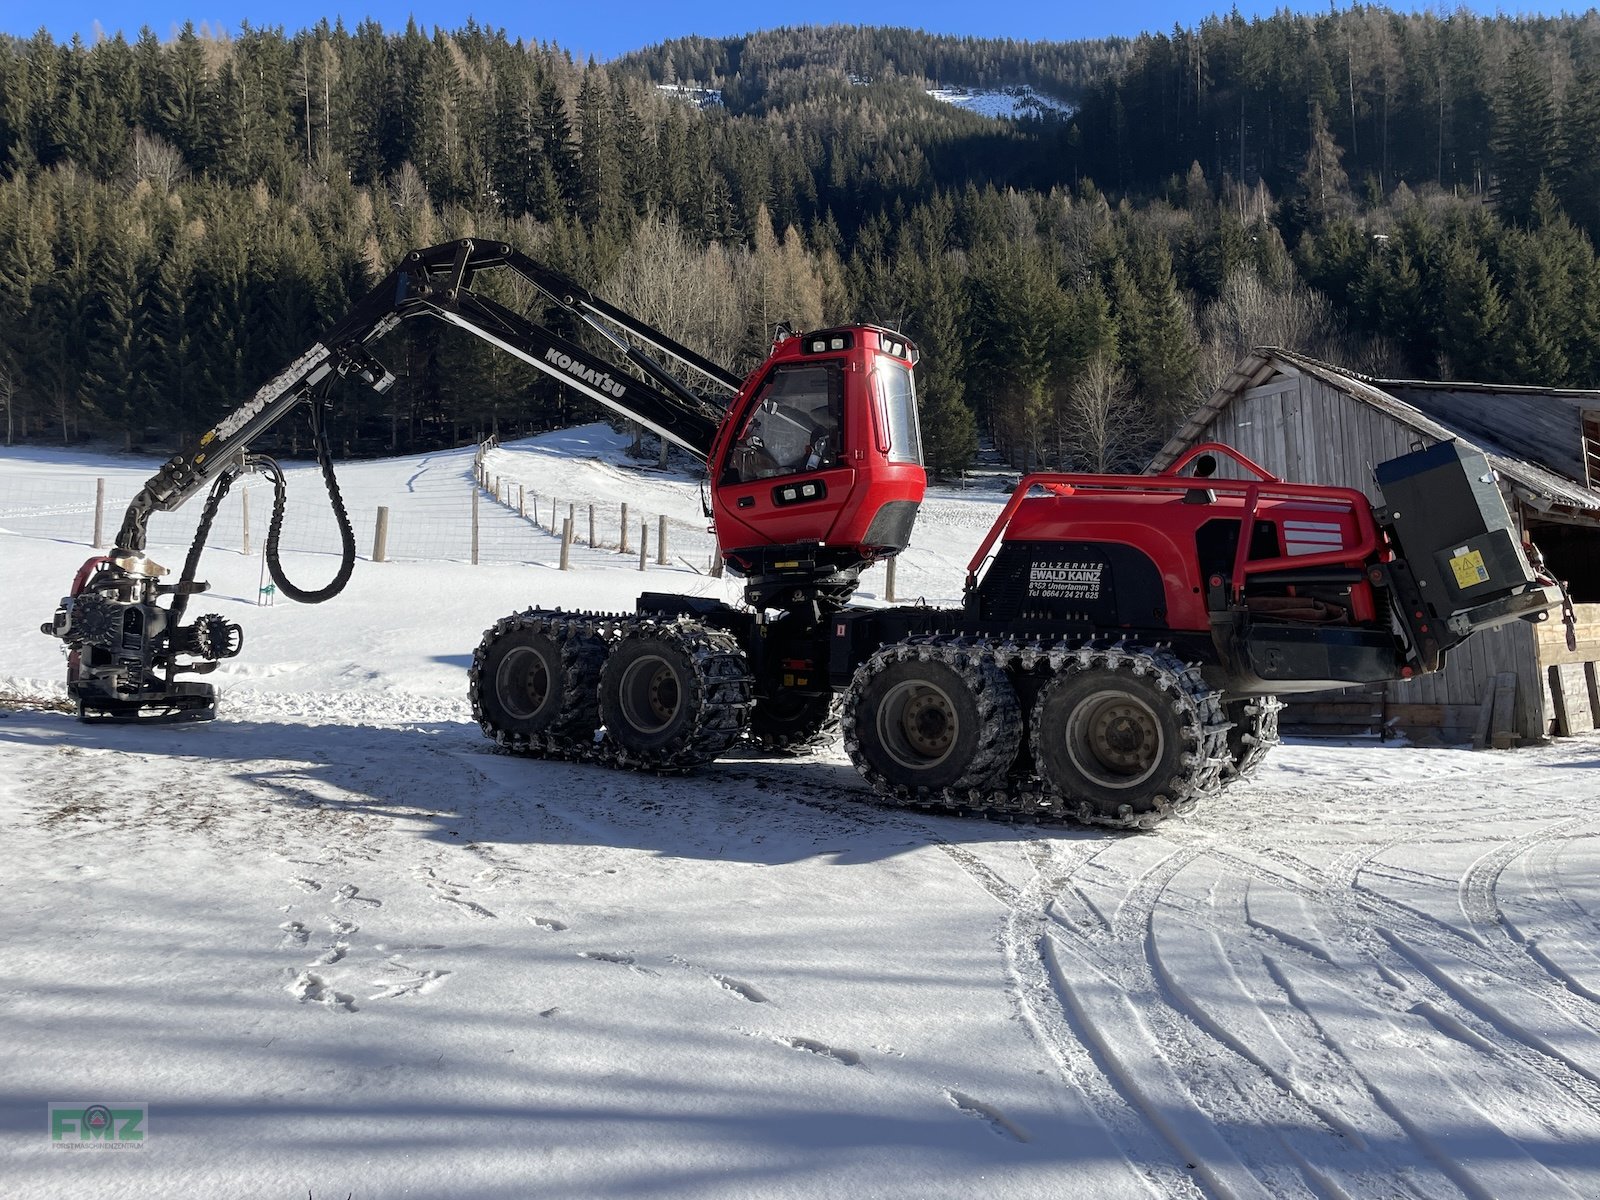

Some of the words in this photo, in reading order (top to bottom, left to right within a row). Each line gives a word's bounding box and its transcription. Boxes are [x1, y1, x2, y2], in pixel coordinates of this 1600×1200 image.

[544, 347, 627, 398] KOMATSU
[1031, 561, 1104, 570] HOLZERNTE
[1030, 570, 1067, 581] EWALD
[1068, 571, 1101, 582] KAINZ
[1047, 582, 1089, 591] Unterlamm
[1041, 590, 1060, 598] 0664
[1064, 590, 1074, 598] 24
[1074, 591, 1083, 599] 21
[1084, 591, 1100, 600] 625
